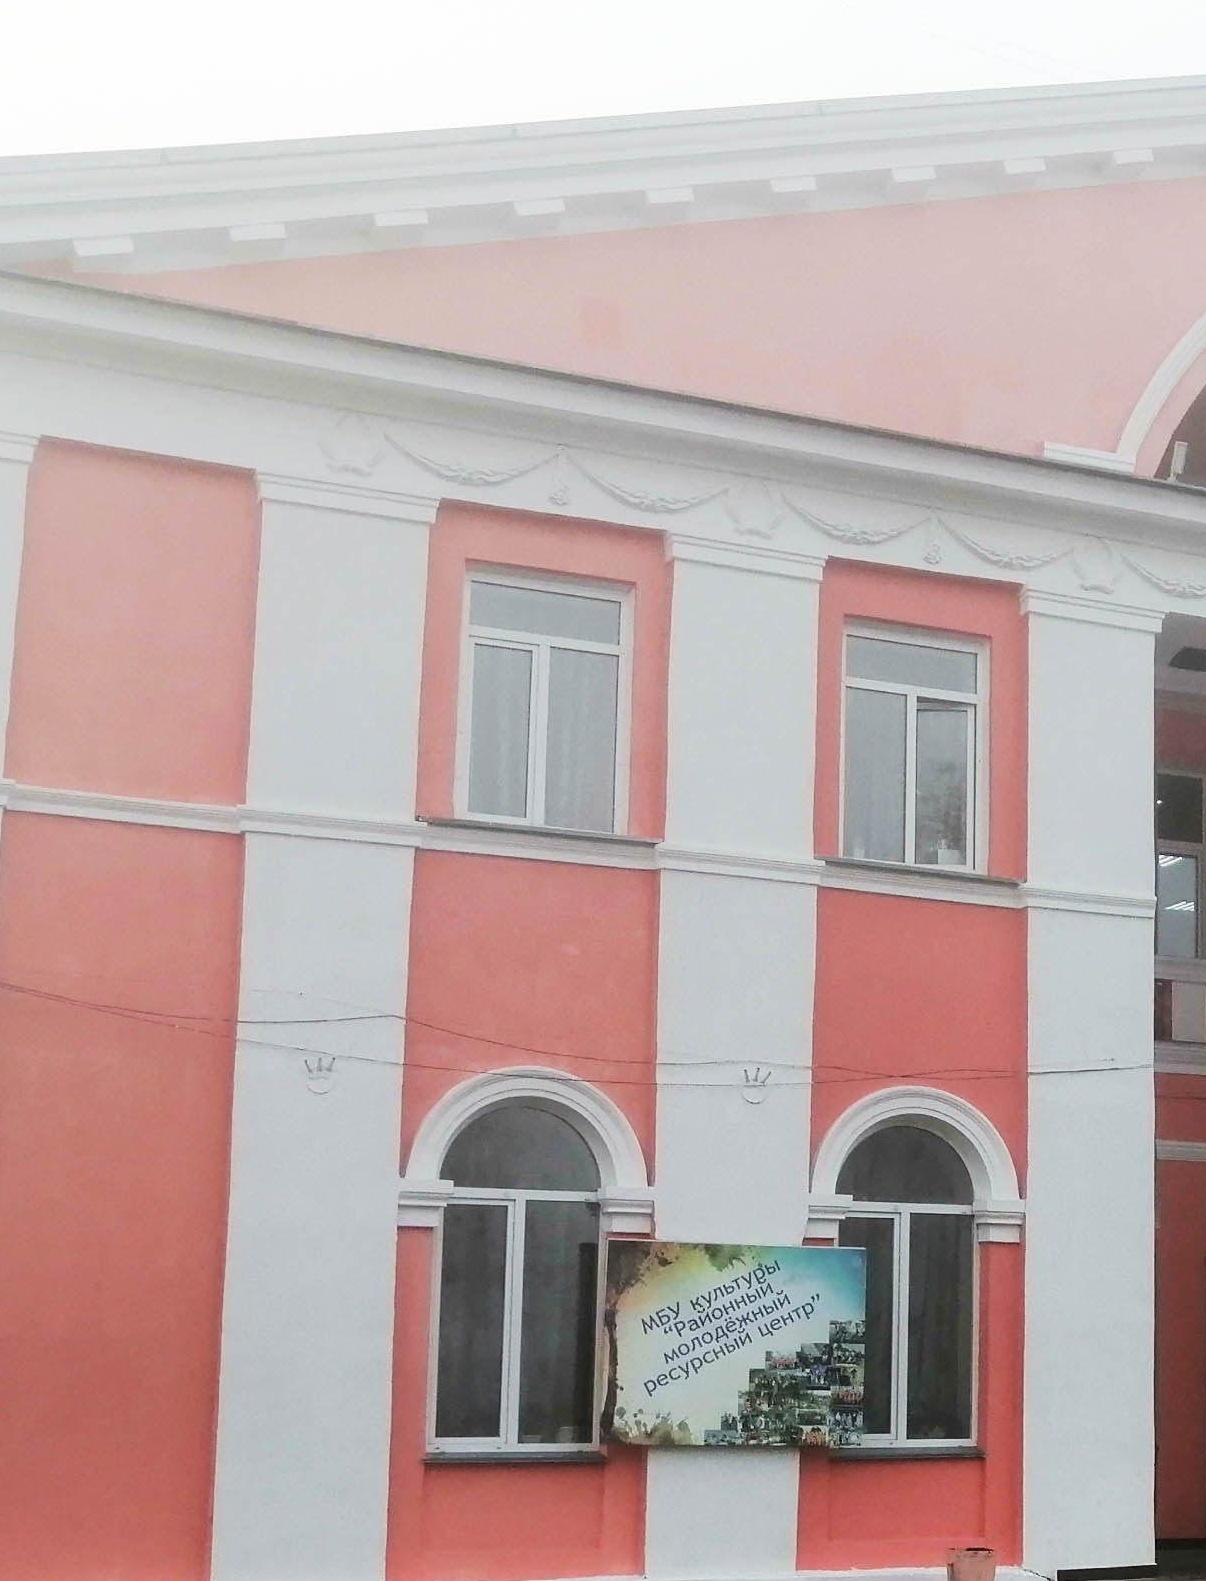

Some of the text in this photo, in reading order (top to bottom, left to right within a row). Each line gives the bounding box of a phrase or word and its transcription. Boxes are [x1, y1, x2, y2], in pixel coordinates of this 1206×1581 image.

[641, 1260, 781, 1335] МБУ культуры
[663, 1290, 792, 1364] молодёжный
[643, 1329, 753, 1397] ресурсный
